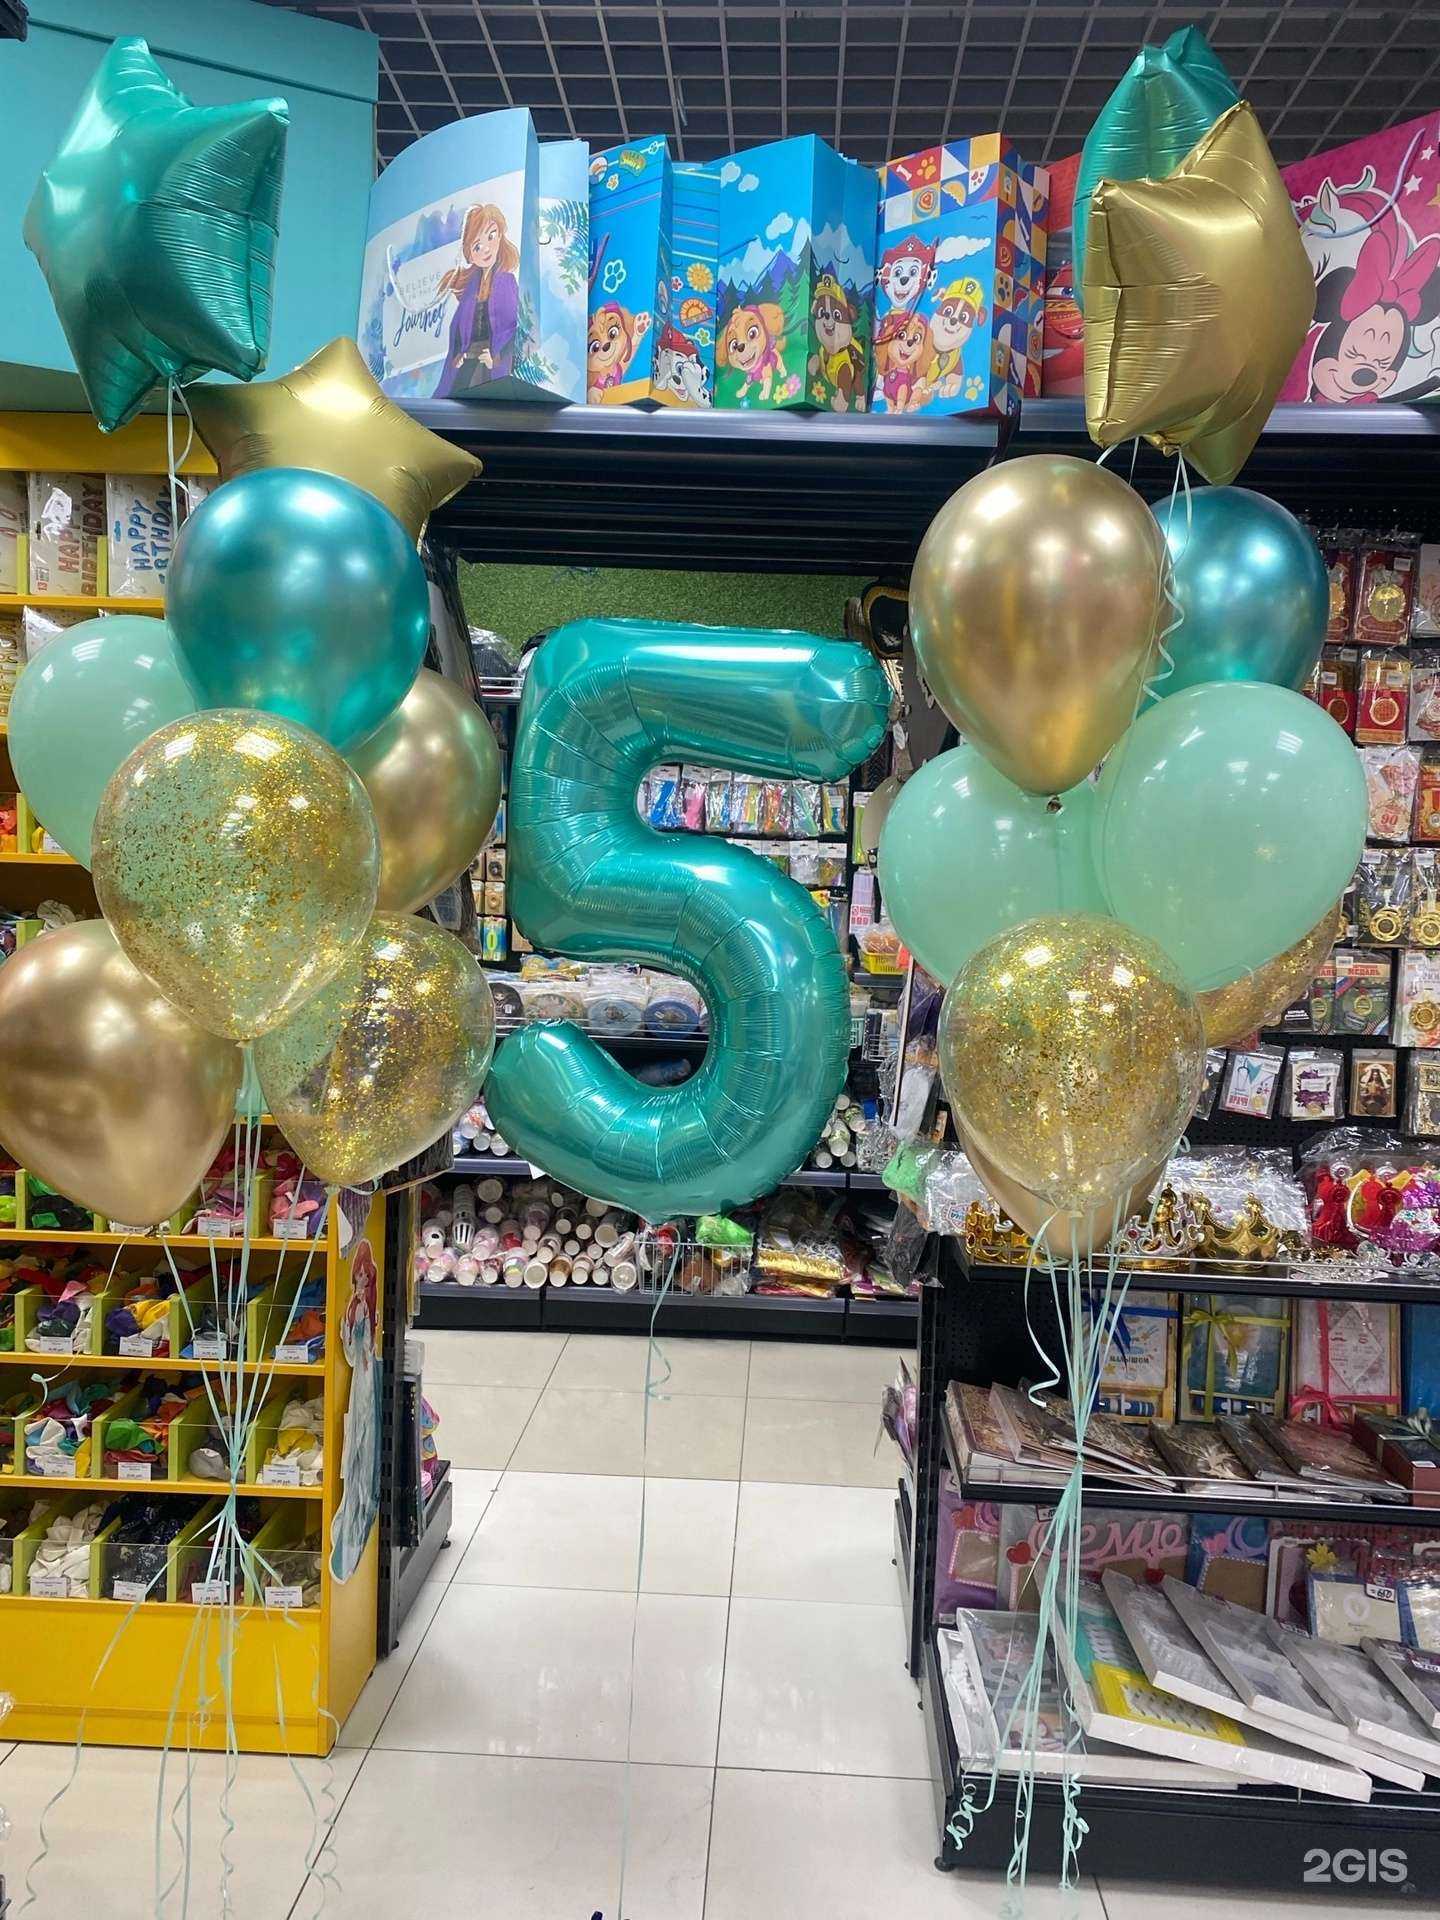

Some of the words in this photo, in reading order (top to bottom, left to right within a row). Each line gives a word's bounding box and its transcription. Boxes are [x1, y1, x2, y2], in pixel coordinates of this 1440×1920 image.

[393, 300, 447, 347] Journey
[128, 499, 152, 571] HAPPY
[1380, 813, 1399, 826] 90
[485, 616, 891, 1223] 5
